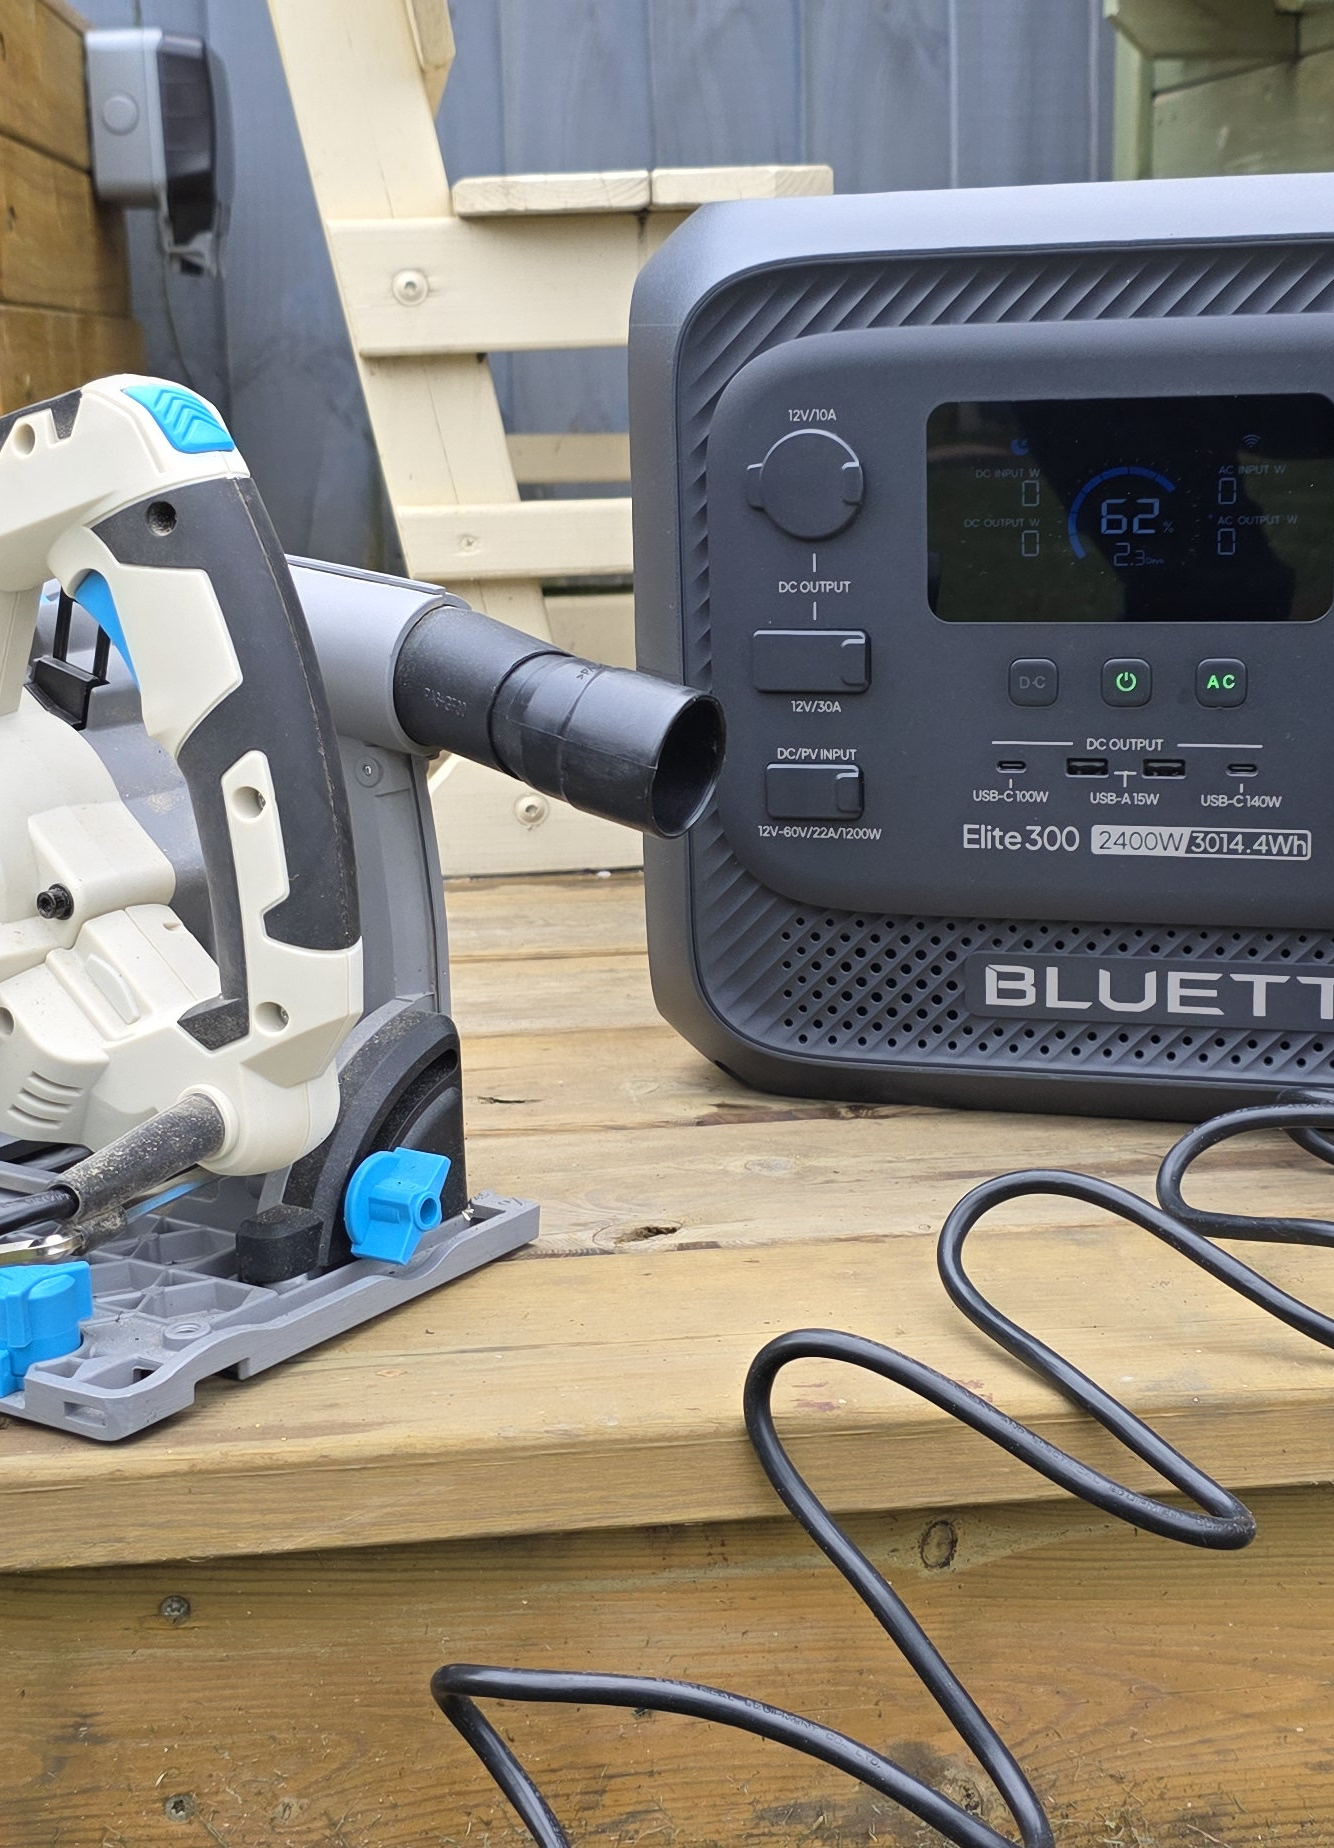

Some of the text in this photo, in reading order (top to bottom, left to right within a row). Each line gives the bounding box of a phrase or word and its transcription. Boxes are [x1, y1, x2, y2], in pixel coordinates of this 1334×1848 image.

[788, 408, 837, 422] 12V/10A
[975, 469, 991, 479] DC
[994, 469, 1025, 478] INPUT
[1219, 465, 1234, 475] AC
[1238, 464, 1269, 475] INPUT
[964, 519, 980, 528] DC
[984, 518, 1025, 528] OUTPUT
[1217, 516, 1233, 525] AC
[1237, 515, 1281, 525] OUTPUT
[778, 581, 851, 593] DC OUTPUT
[790, 700, 842, 713] 12V/30A
[1086, 738, 1164, 751] DC OUTPUT
[777, 747, 857, 761] DC/PV INPUT
[972, 789, 1049, 803] USB-C 100W
[1089, 791, 1160, 805] USB-A 15W
[1200, 794, 1282, 808] USB-C 140W
[757, 825, 882, 840] 12V-60V/22A/1200W
[963, 823, 1080, 851] Elite 300
